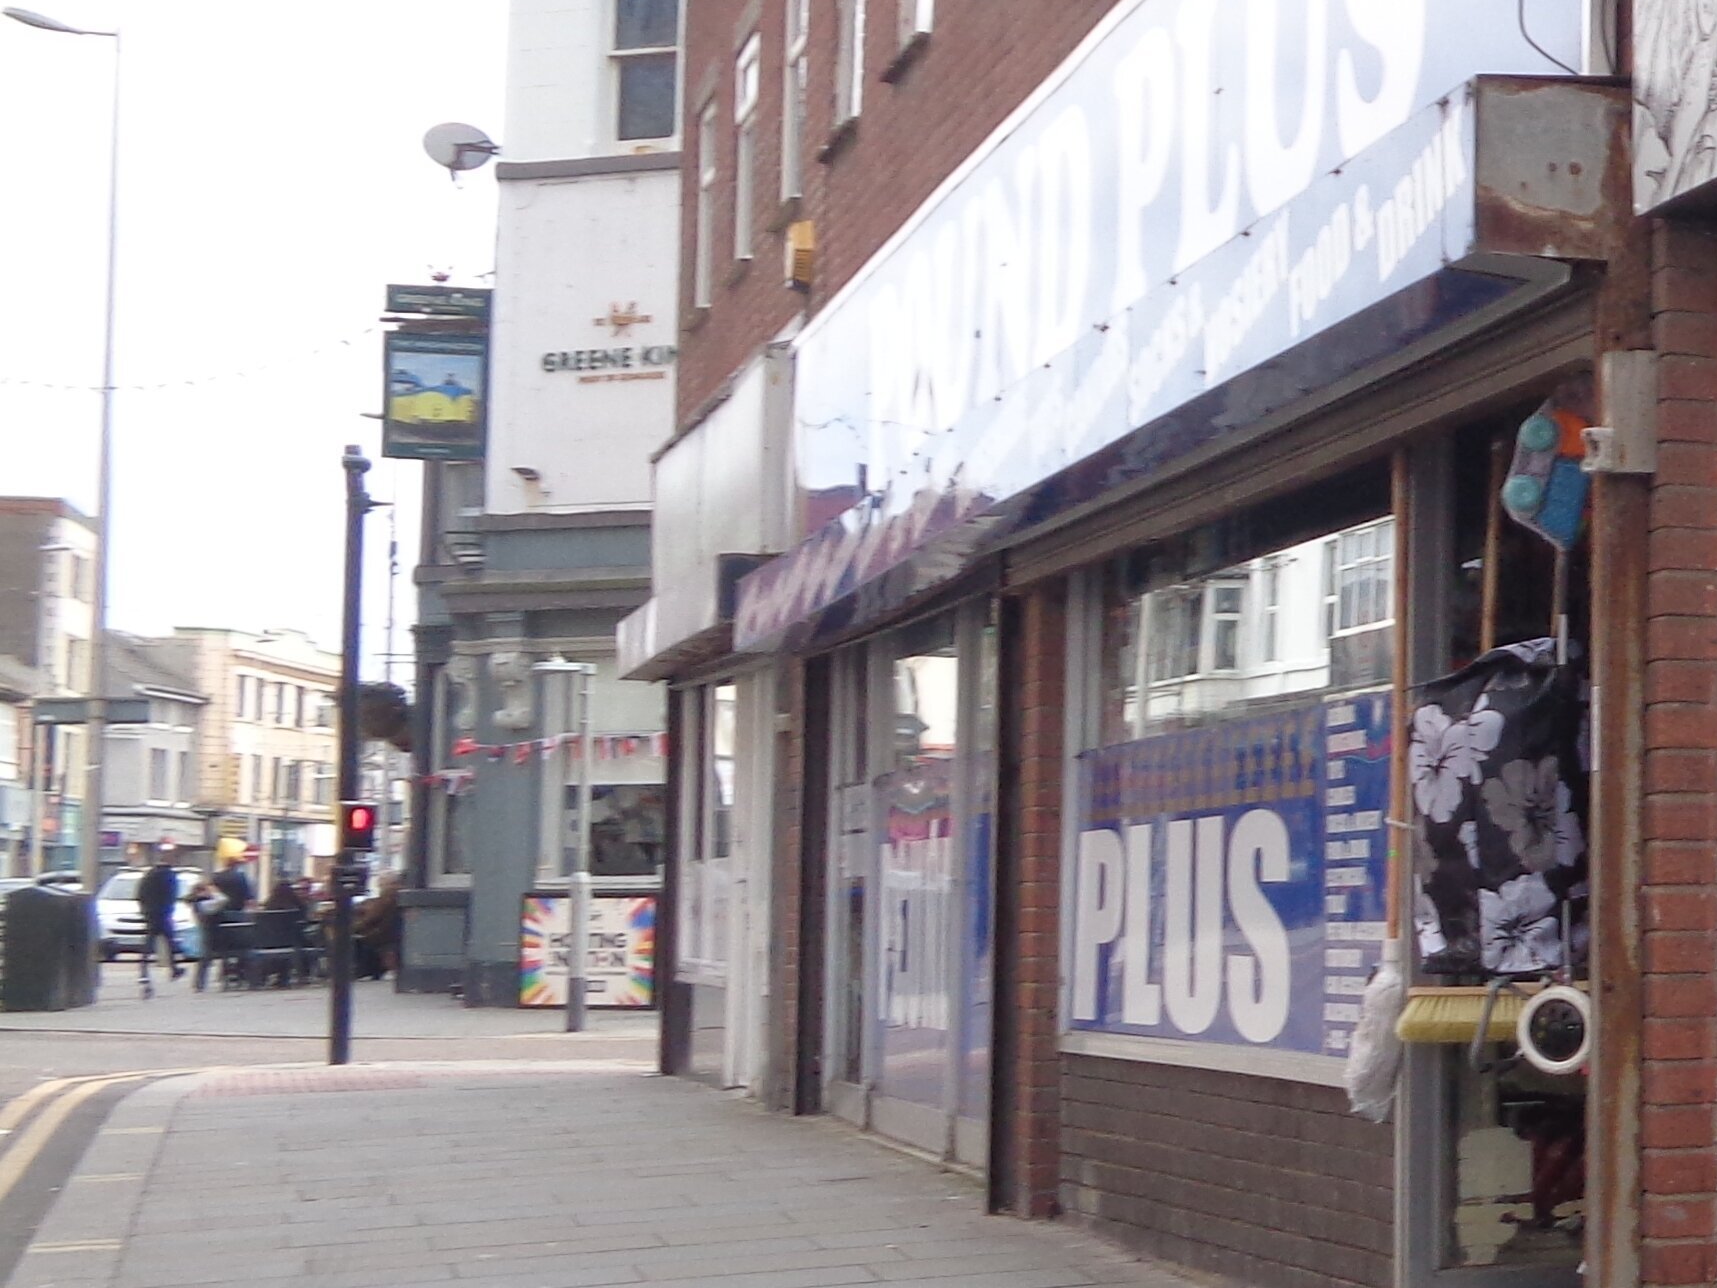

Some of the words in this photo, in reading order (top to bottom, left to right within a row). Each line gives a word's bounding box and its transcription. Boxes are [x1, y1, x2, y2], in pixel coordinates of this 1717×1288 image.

[1289, 202, 1351, 336] FOOD
[1353, 184, 1374, 251] &
[1376, 105, 1466, 282] DRINK
[542, 347, 633, 372] GREENE
[640, 346, 678, 365] KIN
[1073, 809, 1292, 1044] PLUS
